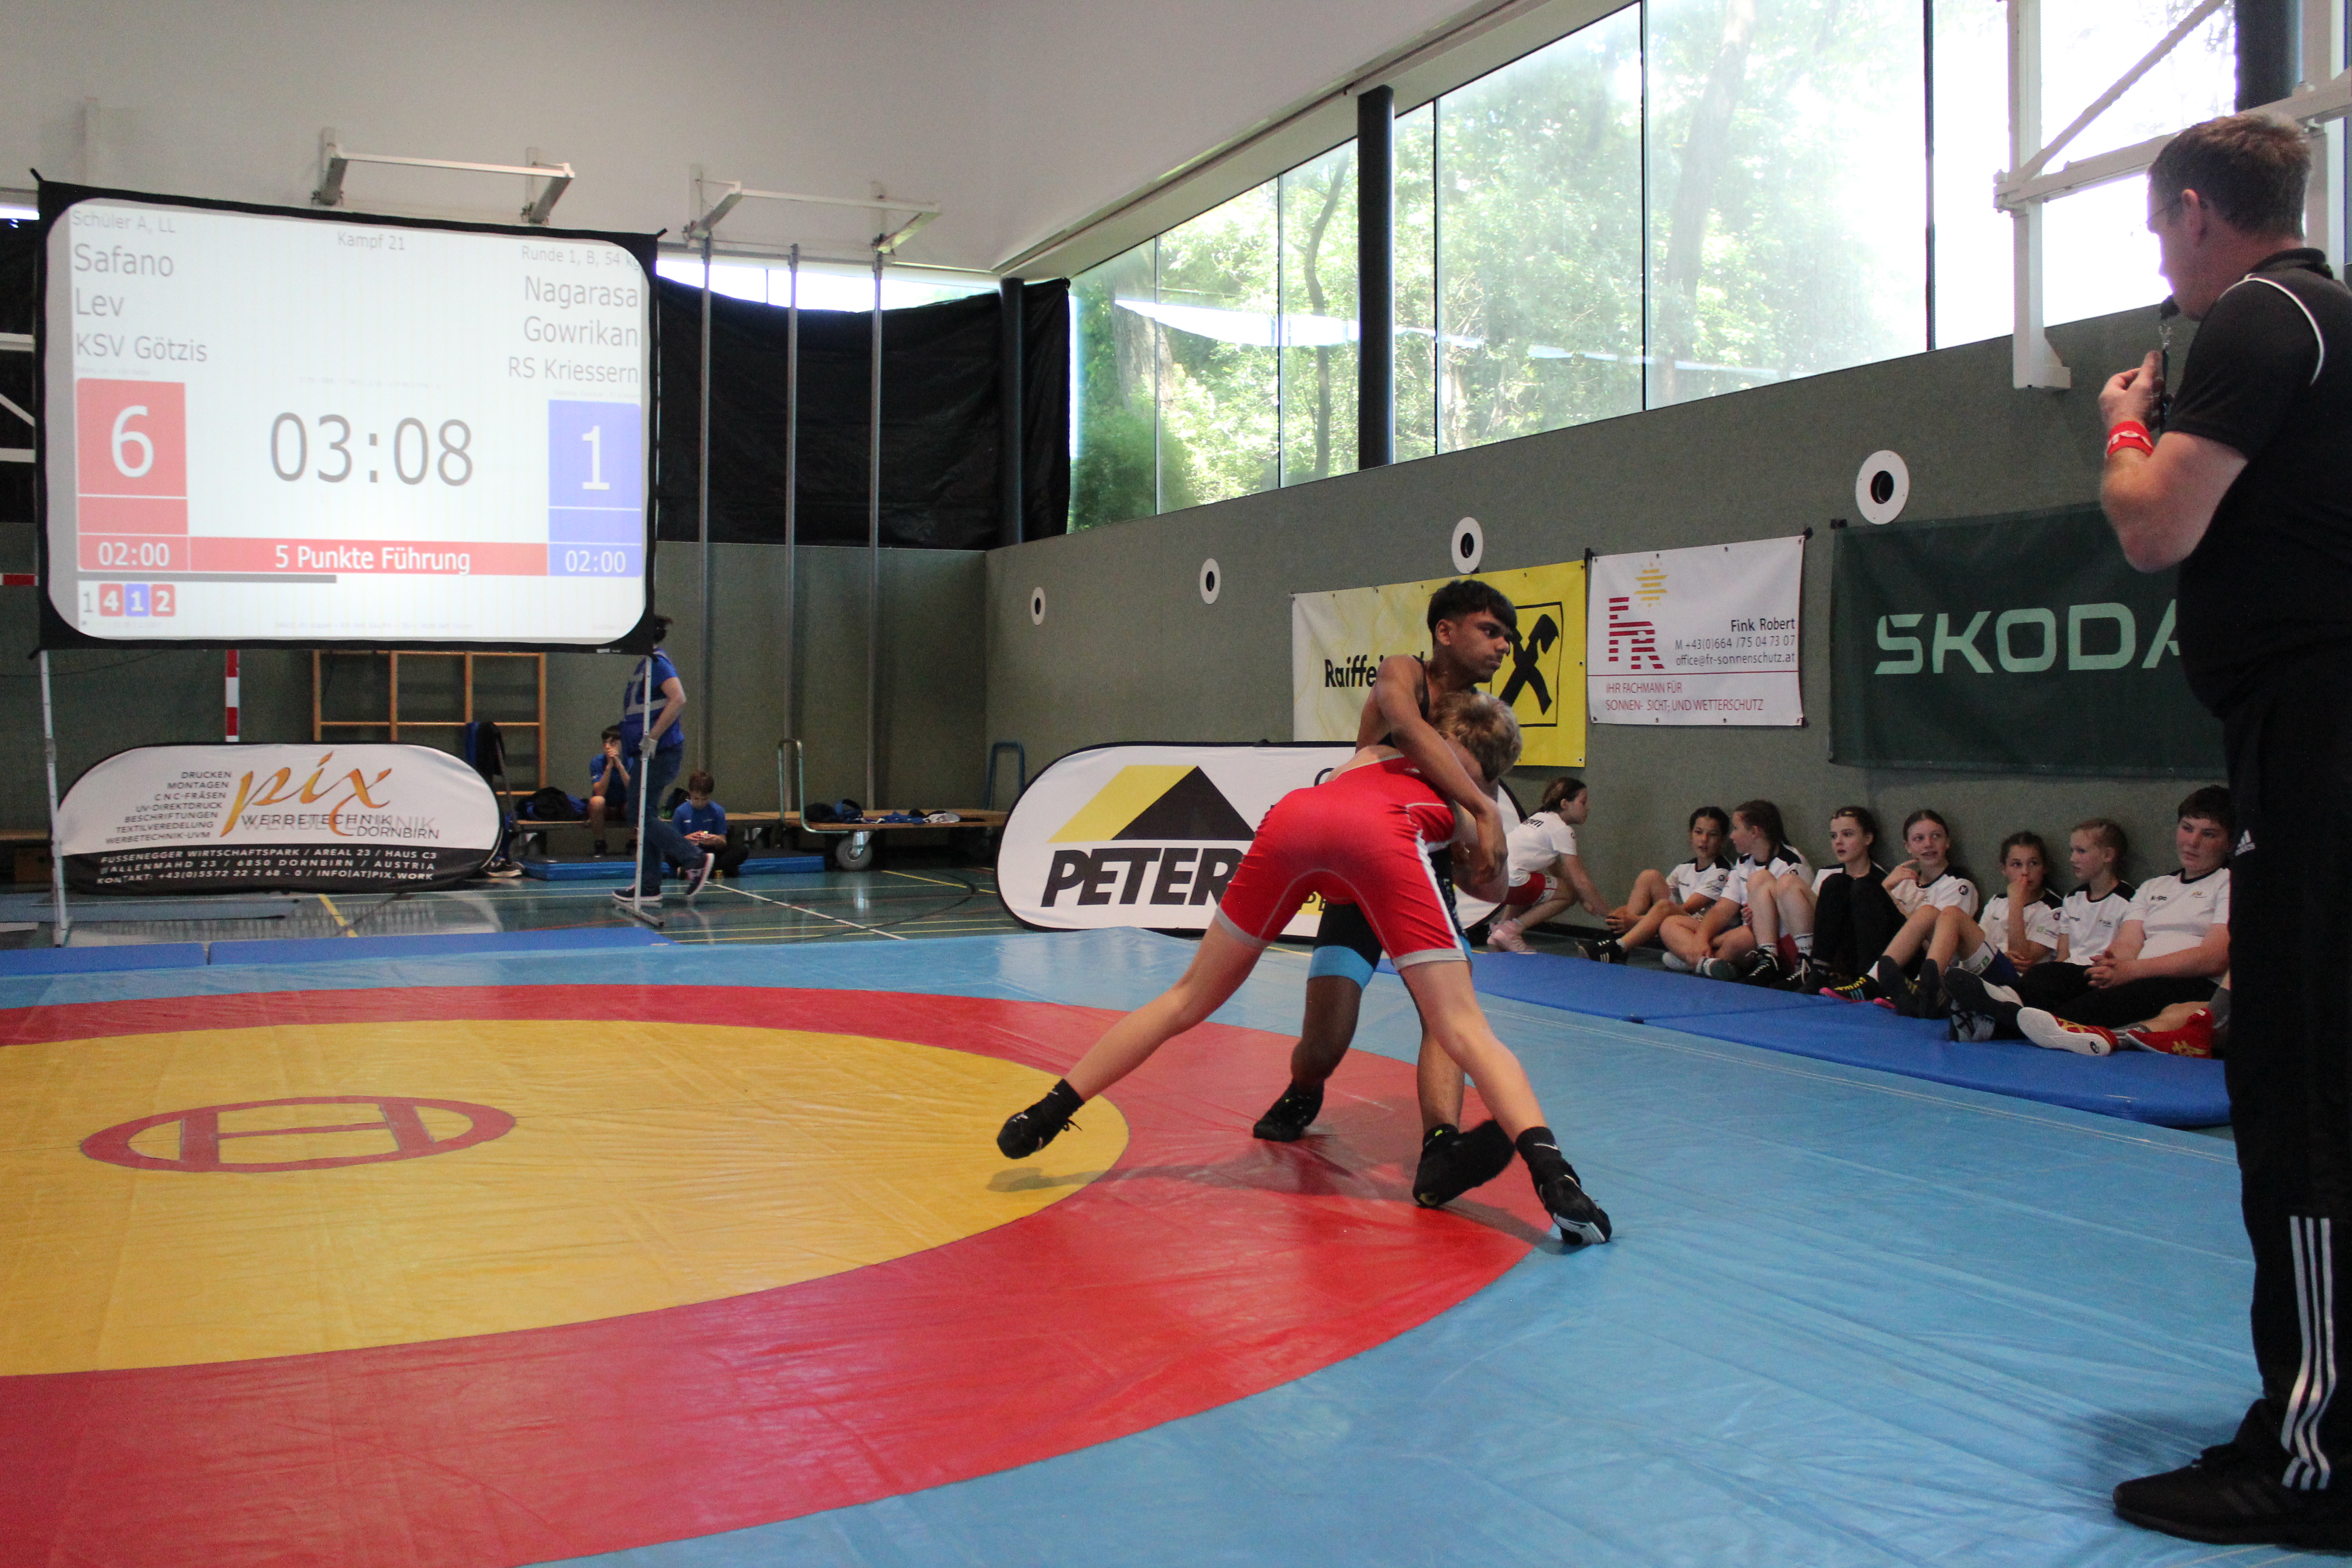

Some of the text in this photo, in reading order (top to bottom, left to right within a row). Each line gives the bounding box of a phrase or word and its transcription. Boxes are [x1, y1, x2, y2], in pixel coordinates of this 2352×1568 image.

[73, 210, 131, 229] Schüler
[338, 232, 405, 250] Kampf 21
[74, 243, 174, 277] Safano
[521, 245, 564, 262] Runde
[605, 252, 620, 265] 54
[76, 288, 125, 317] Lev
[524, 276, 638, 309] Nagarasa
[524, 316, 638, 347] Gowrikan
[76, 333, 208, 362] KSV Götzis
[509, 357, 639, 383] RS Kriessern
[111, 405, 154, 478] 6
[270, 412, 473, 486] 03:08
[582, 426, 610, 490] 1
[98, 542, 170, 567] 02:00
[275, 545, 470, 575] 5 Punkte Führung
[565, 550, 627, 573] 02:00
[83, 591, 171, 612] 1 4 1 2
[1731, 617, 1795, 632] Fink Robert
[1675, 640, 1683, 650] M
[1755, 636, 1767, 647] 04
[1769, 635, 1780, 647] 73
[1783, 635, 1795, 646] 07
[1676, 652, 1795, 666] office@fr-sonnenschutz.at
[1324, 654, 1383, 688] Raiffe
[1606, 680, 1683, 693] IHR FACHMANN FÜR
[1606, 699, 1643, 710] SONNEN-
[1671, 699, 1692, 710] UND
[1693, 698, 1764, 710] WETTERSCHUTZ
[167, 781, 229, 789] MONTAGEN
[181, 771, 232, 779] DRUCKEN
[220, 750, 392, 838] pix
[124, 811, 219, 823] BESCHRIFTUNGEN
[136, 802, 223, 813] UV-DIREKTDRUCK
[241, 813, 392, 825] WERBETECHNIK
[356, 826, 440, 839] DORNBIRN
[100, 851, 183, 863] FUSSENEGGER
[187, 849, 300, 857] WIRTSCHAFTSPARK
[385, 850, 417, 858] HAUS
[373, 860, 435, 870] AUSTRIA
